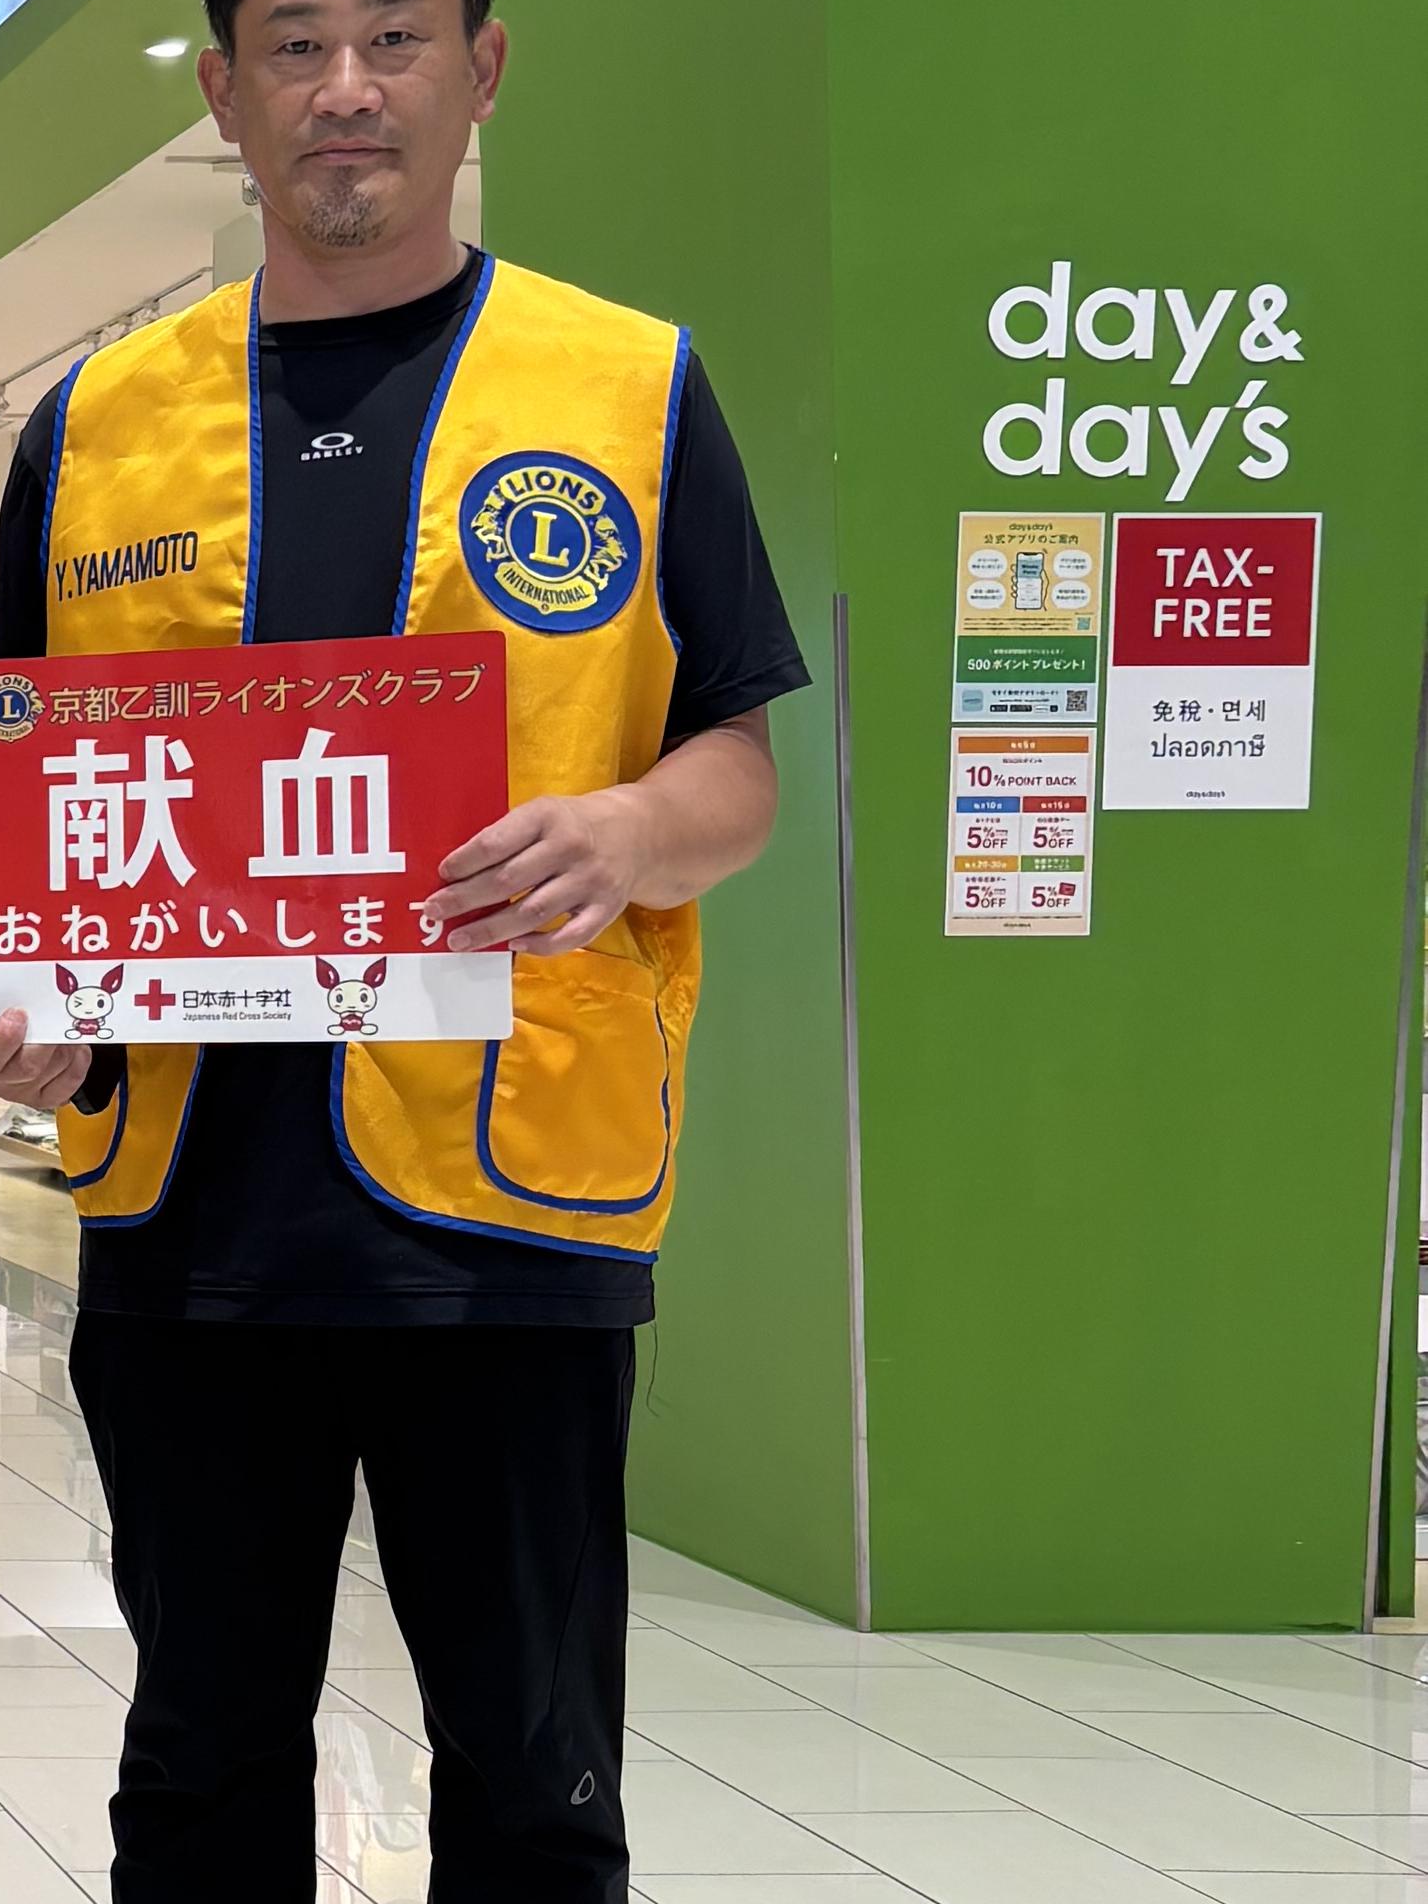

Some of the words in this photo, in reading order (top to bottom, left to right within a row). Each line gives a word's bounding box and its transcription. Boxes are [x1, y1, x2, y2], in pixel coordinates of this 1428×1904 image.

[986, 260, 1304, 385] day&
[300, 446, 364, 462] OAKLEY
[982, 377, 1290, 502] day's
[506, 470, 600, 510] LIONS
[528, 510, 570, 568] L
[55, 530, 199, 602] Y.YAMAMOTO
[1156, 547, 1275, 588] TAX-
[502, 567, 591, 605] INTERNATIONAL
[1153, 597, 1273, 638] FREE
[2, 694, 21, 719] L
[48, 663, 487, 725] 京都乙訓ライオンズクラブ
[1007, 776, 1042, 787] POINT
[1045, 776, 1077, 786] BACK
[42, 726, 406, 893] 献血
[982, 838, 1008, 849] OFF
[1048, 838, 1074, 849] OFF
[981, 897, 1006, 908] OFF
[1046, 898, 1071, 908] OFF
[182, 989, 292, 1009] 日本赤十字社
[222, 1011, 238, 1021] Red
[239, 1011, 261, 1020] Cross
[262, 1011, 292, 1021] Society
